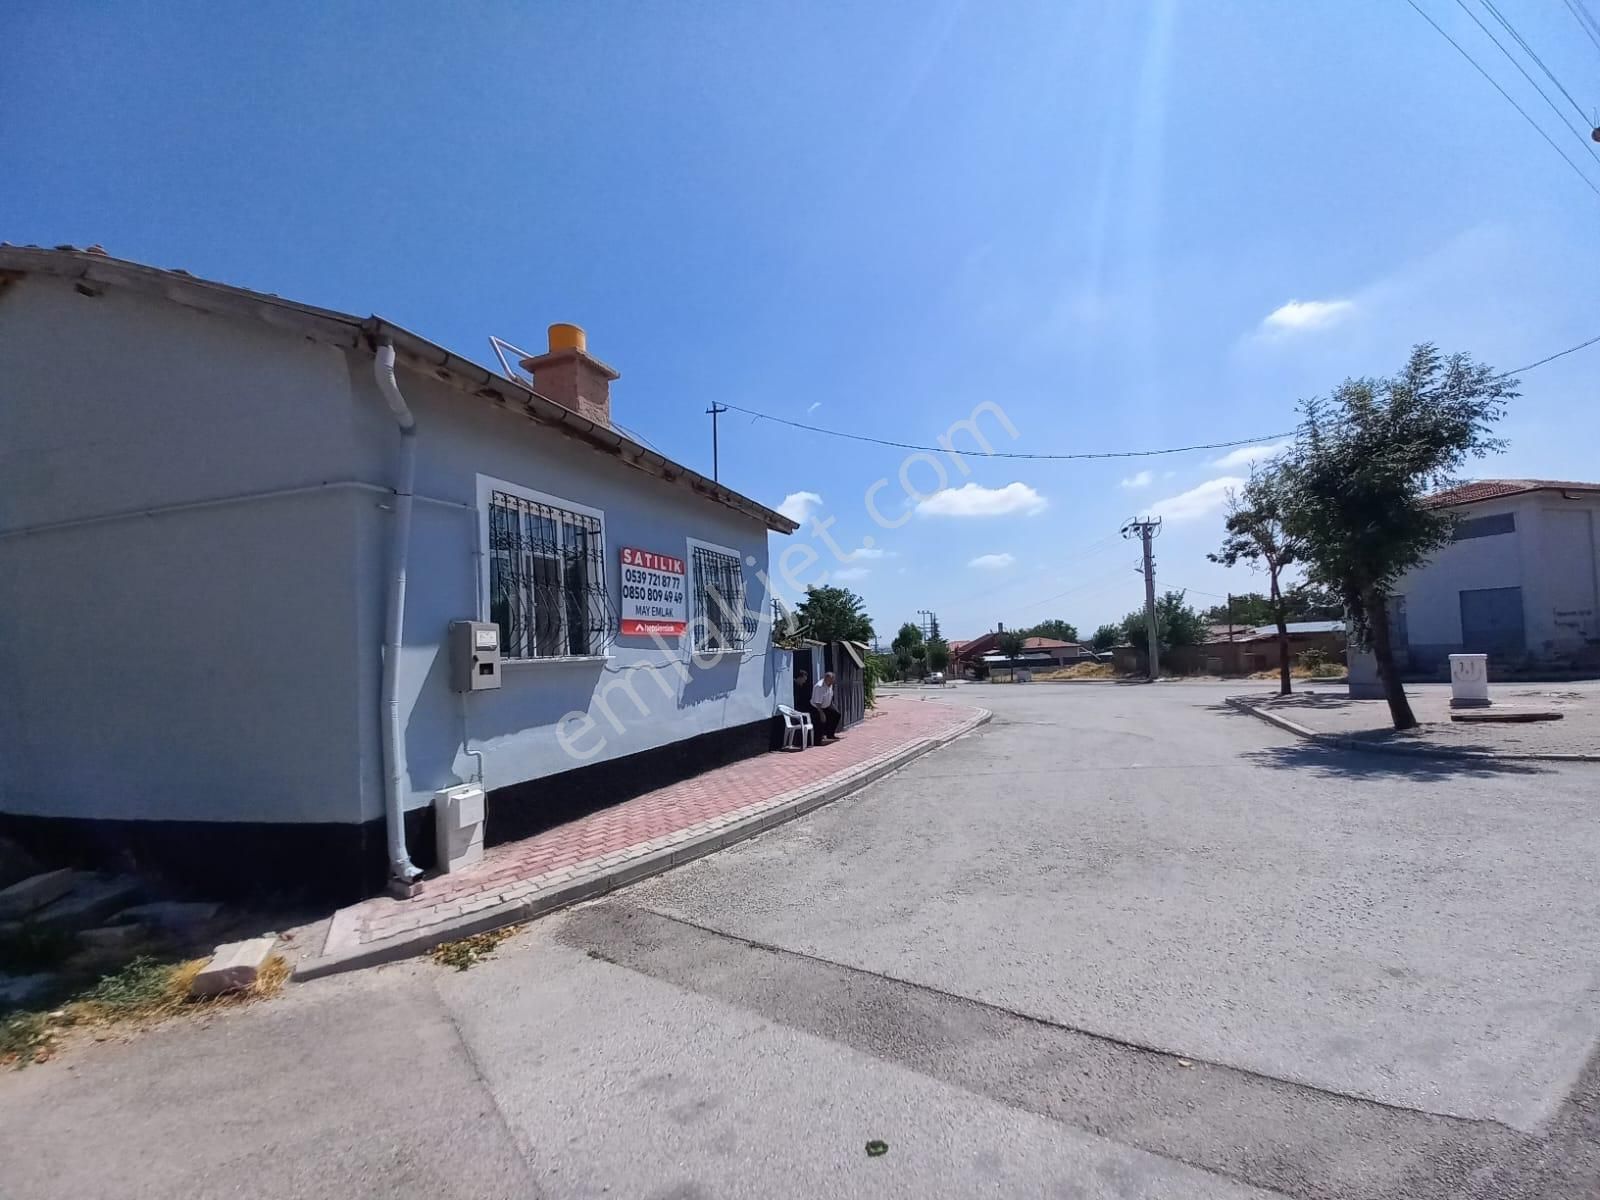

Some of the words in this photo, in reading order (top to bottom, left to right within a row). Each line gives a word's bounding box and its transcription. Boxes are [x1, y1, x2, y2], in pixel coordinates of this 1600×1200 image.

[623, 548, 682, 573] SATILIK
[625, 568, 647, 585] 0539
[648, 572, 660, 586] 721
[661, 575, 671, 588] 87
[671, 576, 680, 590] 77
[622, 585, 646, 601] 0850
[647, 588, 663, 602] 809
[664, 590, 673, 603] 49
[673, 592, 683, 604] 49
[635, 605, 651, 616] MAY
[651, 606, 674, 617] EMLAK
